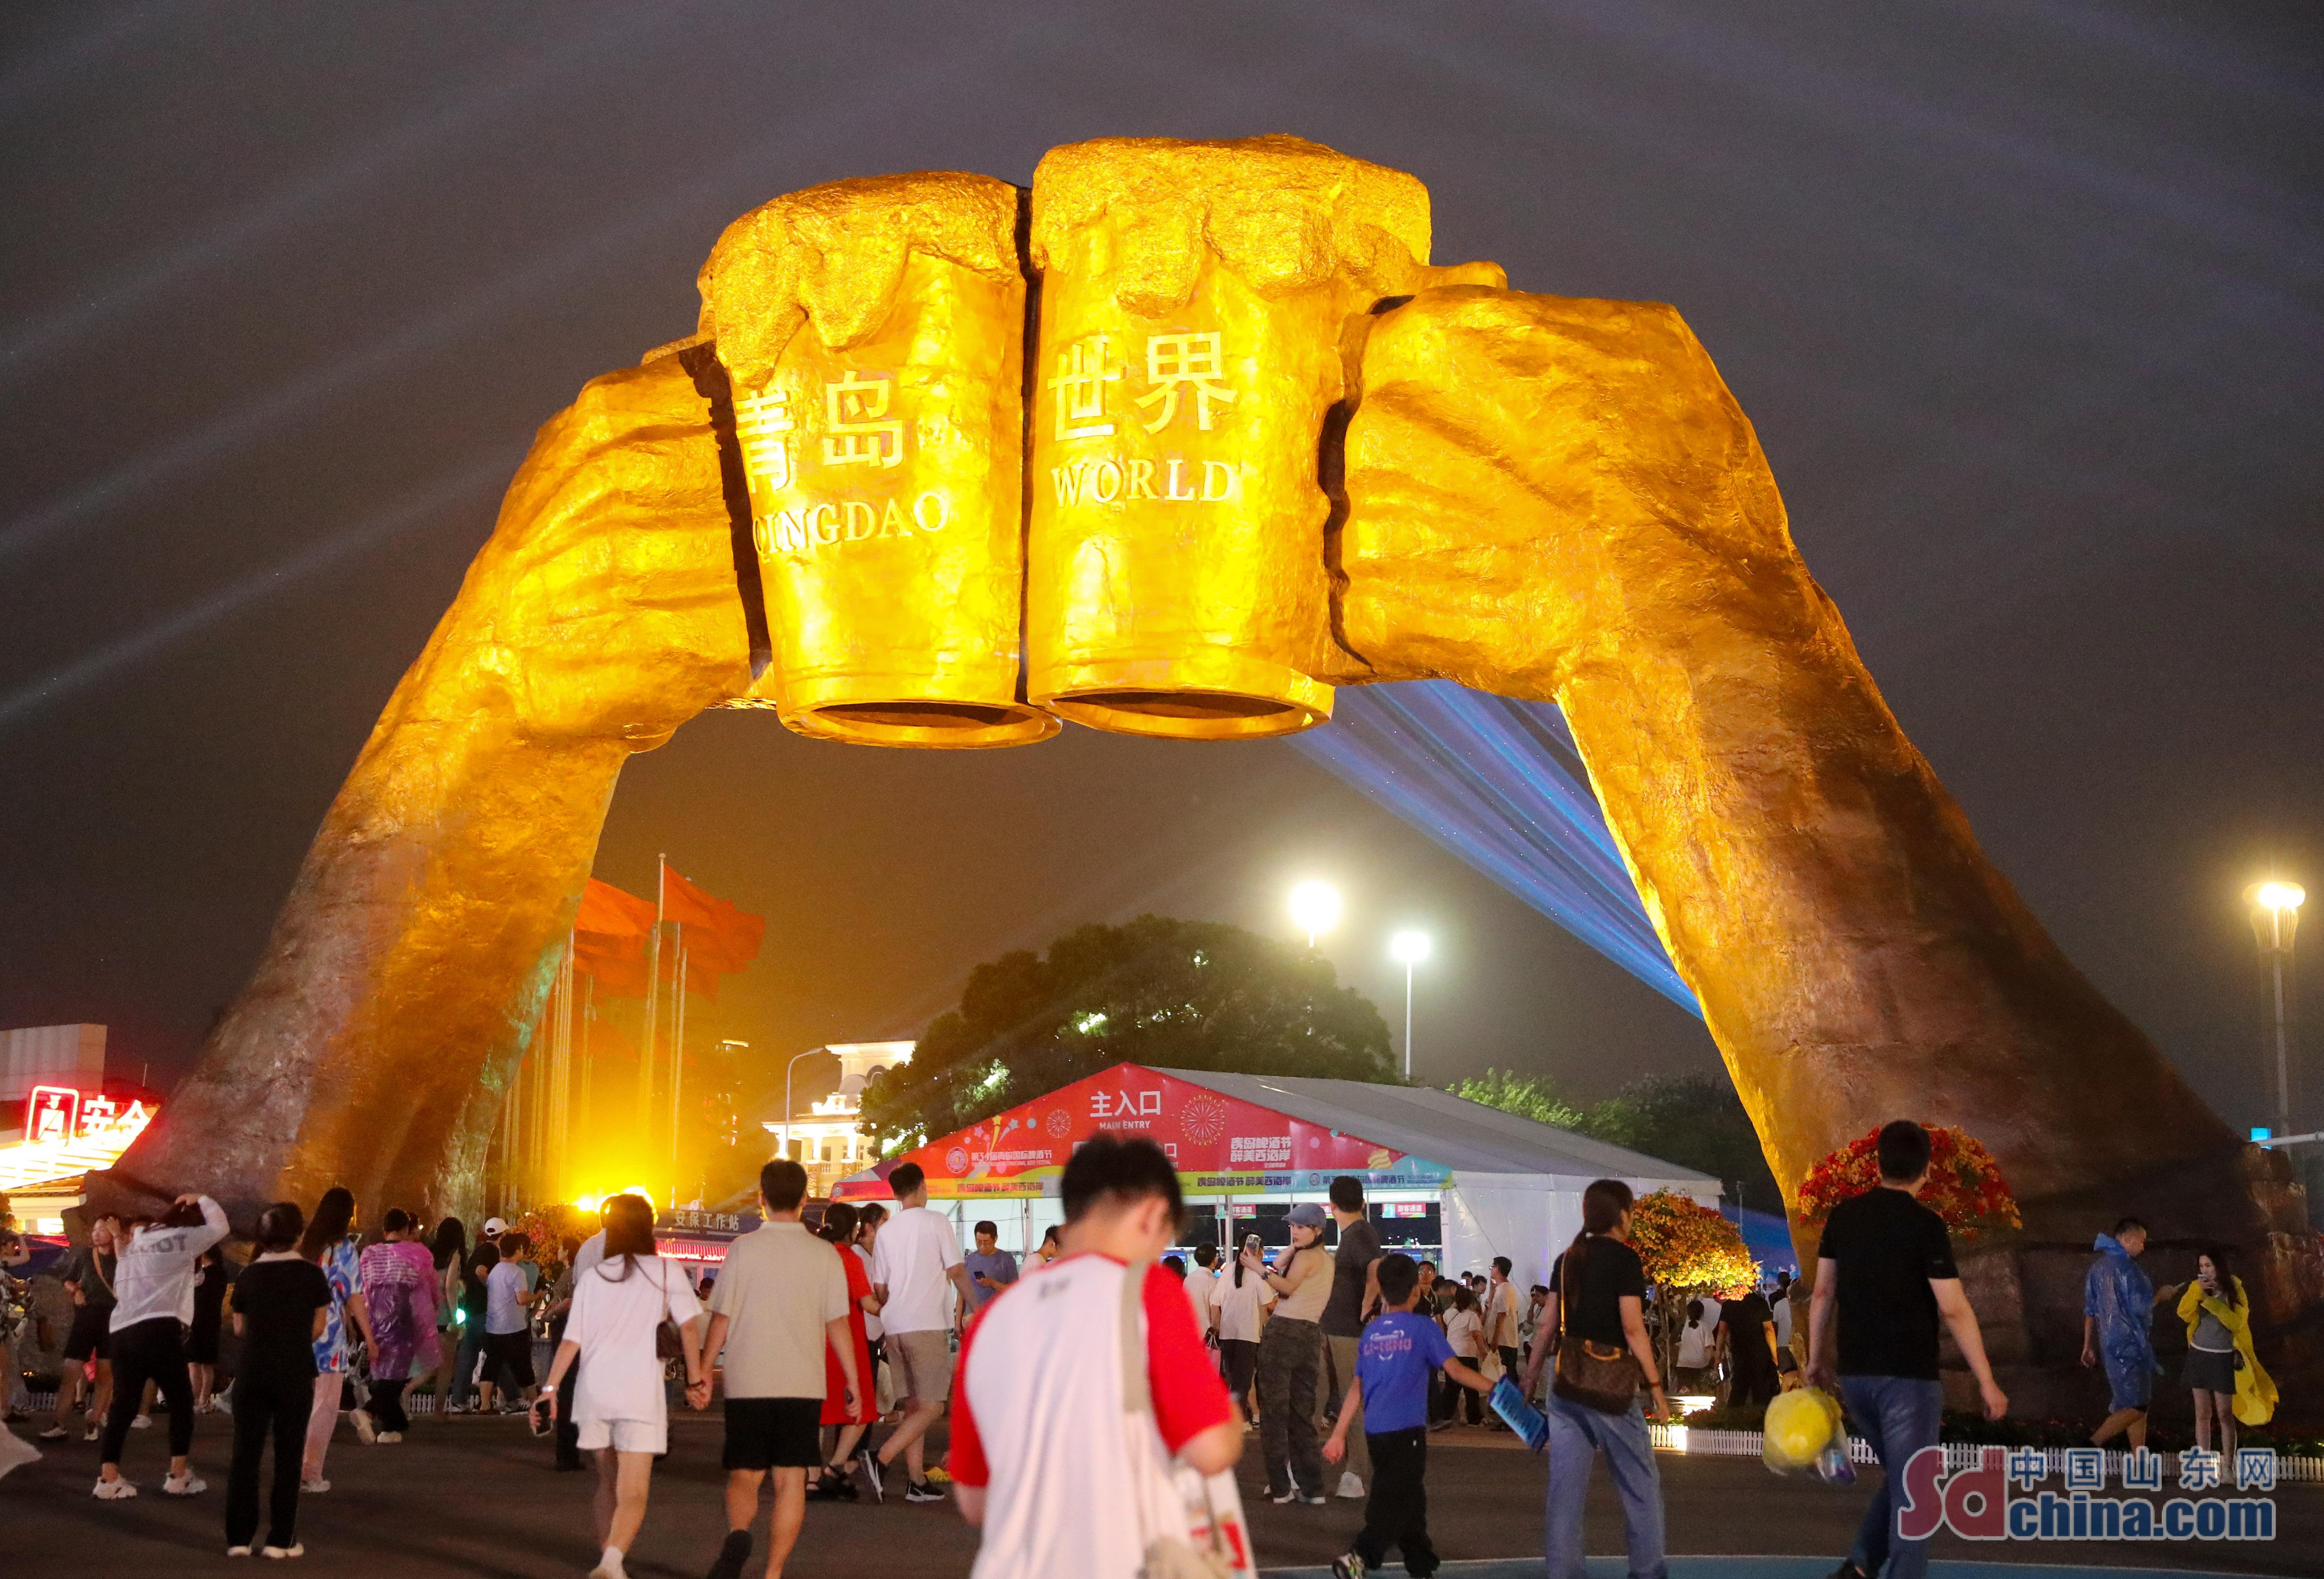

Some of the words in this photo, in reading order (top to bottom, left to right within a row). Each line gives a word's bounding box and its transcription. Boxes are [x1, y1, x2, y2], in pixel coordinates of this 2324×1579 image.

[1047, 331, 1239, 442] 世界
[735, 370, 904, 494] 青岛
[1051, 457, 1237, 508] WORLD
[752, 491, 950, 564] QINGDAO
[1090, 1090, 1160, 1117] 主入口
[1099, 1121, 1121, 1130] MAIN
[1123, 1120, 1151, 1129] ENTRY
[1230, 1137, 1292, 1150] 青岛啤酒节
[1230, 1149, 1291, 1162] 醉美西海岸
[1197, 1176, 1244, 1187] 青岛啤酒节
[1245, 1176, 1291, 1186] 醉美西海岸
[674, 1210, 740, 1231] 安保工作站
